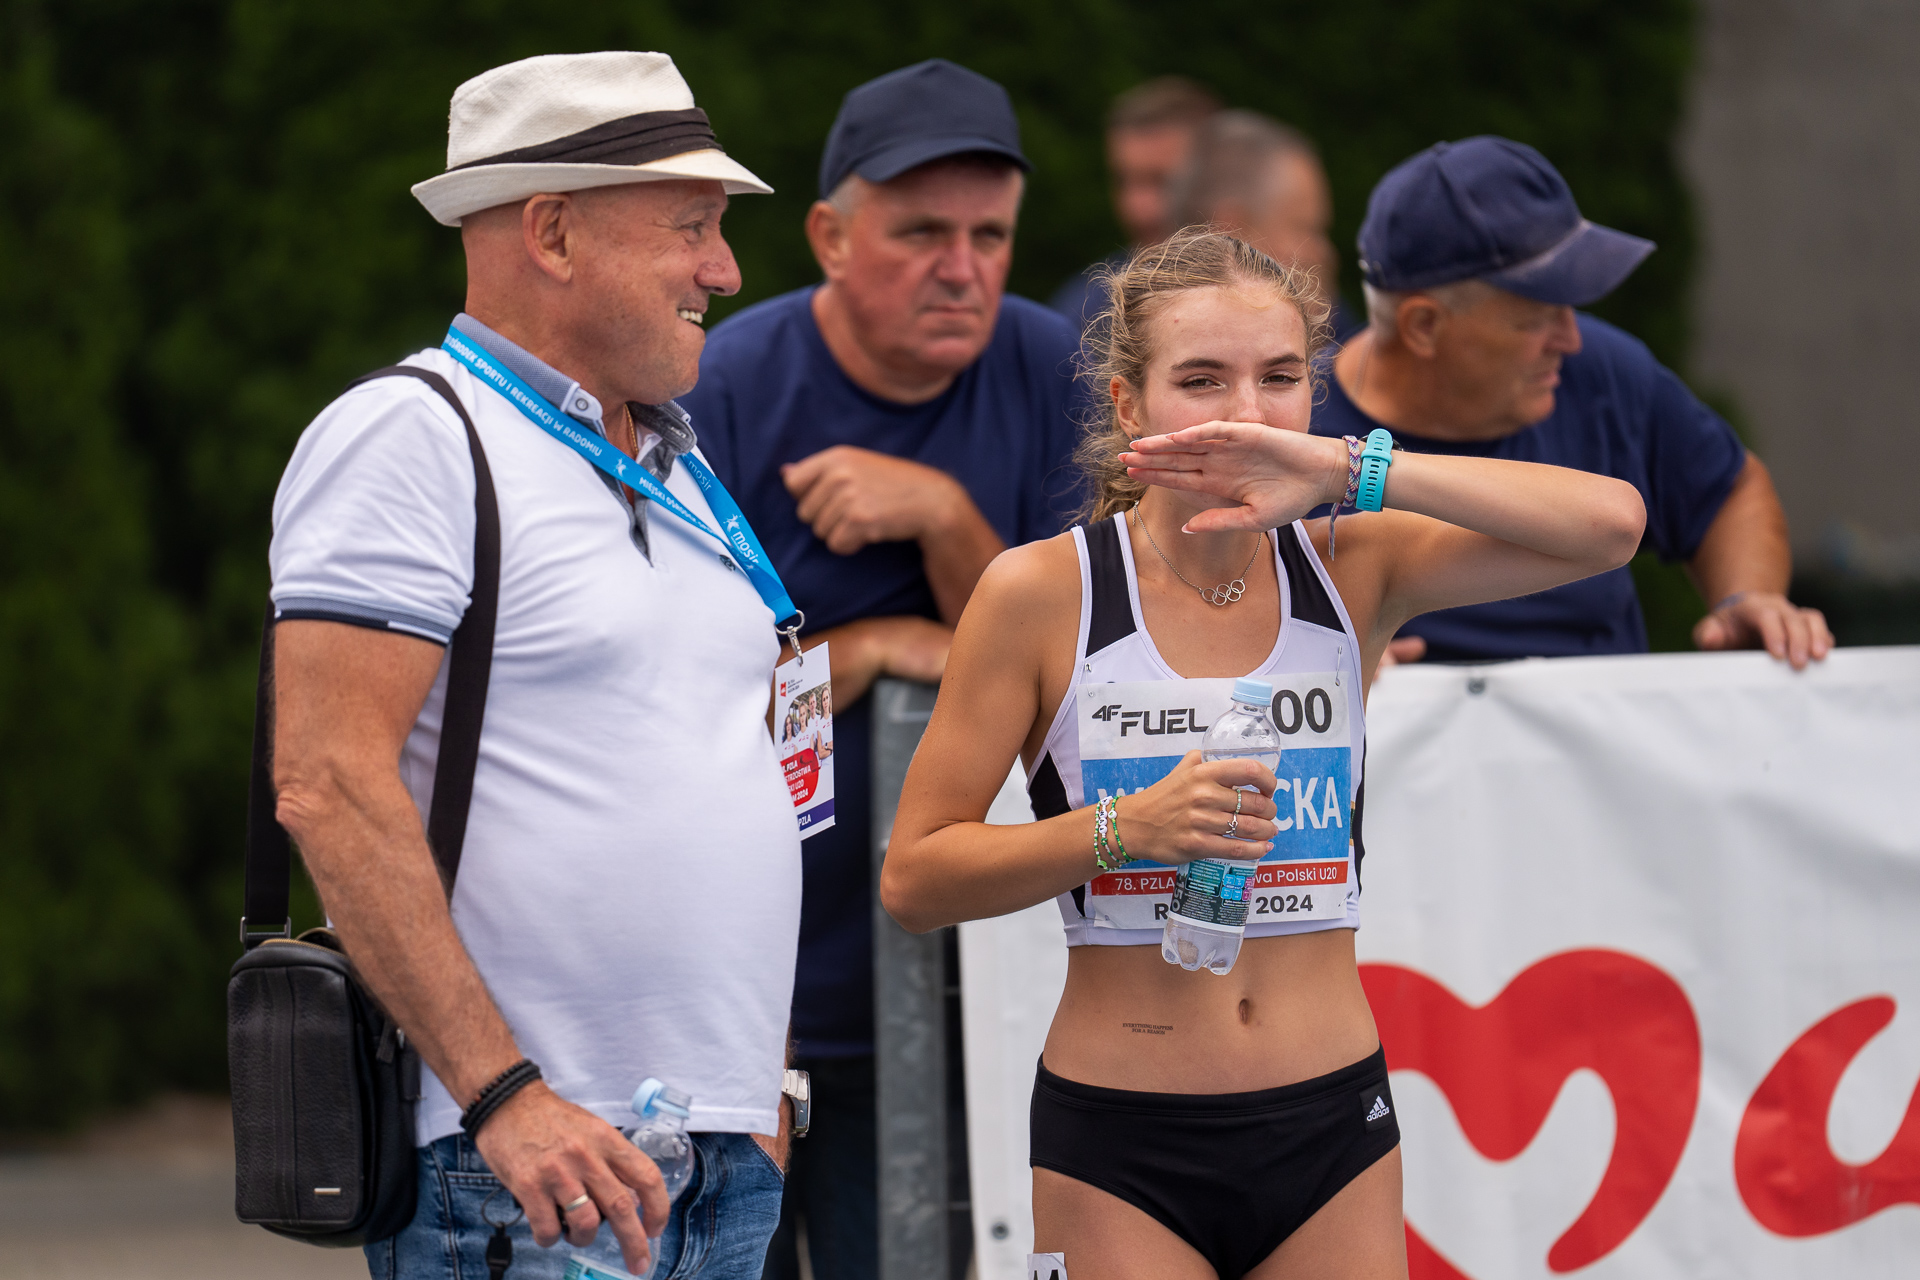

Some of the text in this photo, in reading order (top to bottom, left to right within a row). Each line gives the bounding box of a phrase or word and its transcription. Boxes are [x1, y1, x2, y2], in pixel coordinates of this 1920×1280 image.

[448, 338, 478, 363] ŚRODEK
[474, 358, 508, 387] SPORTU
[505, 382, 513, 392] I
[510, 386, 554, 426] REKREACJI
[553, 420, 564, 432] W
[562, 426, 603, 457] RADOMIU
[688, 460, 712, 492] mosir
[732, 531, 759, 564] mosir
[1120, 708, 1210, 737] FUEL
[1271, 687, 1333, 735] 00
[1271, 776, 1343, 832] CKA
[1115, 878, 1137, 891] 78.
[1142, 877, 1175, 890] PZLA
[1276, 867, 1318, 883] Polski
[1319, 866, 1338, 880] U20
[1255, 894, 1314, 914] 2024
[1366, 1106, 1390, 1122] adidas
